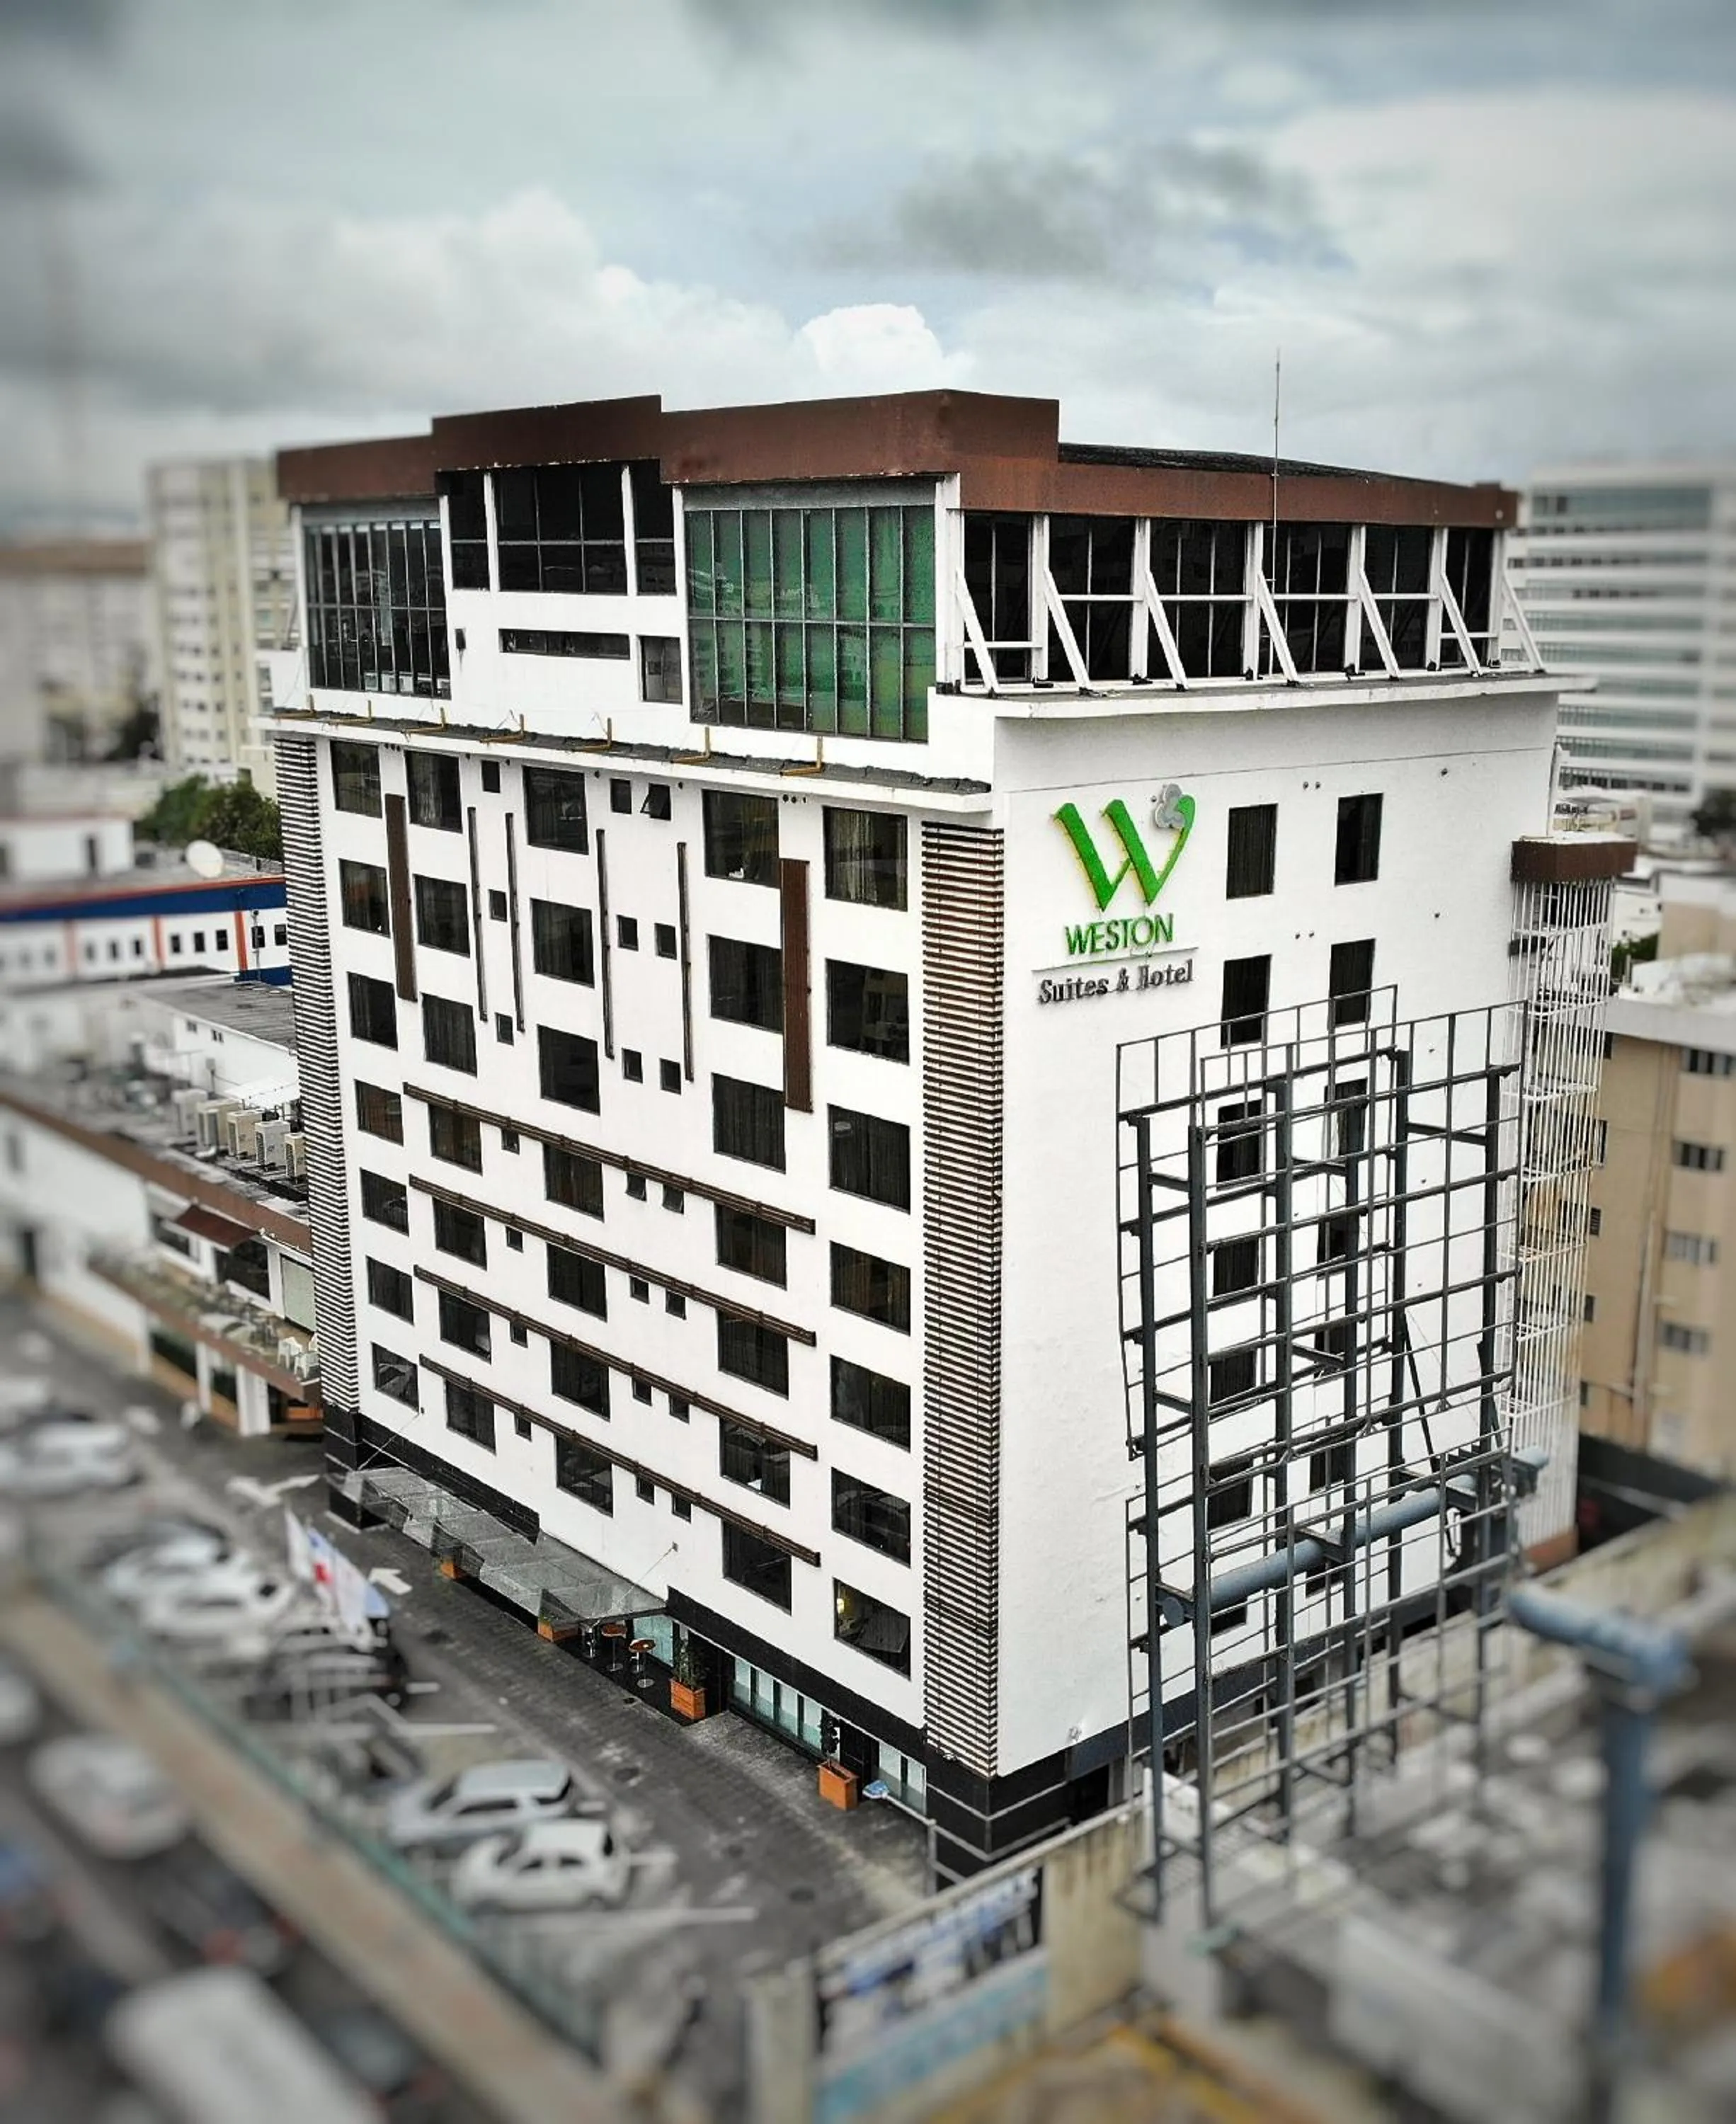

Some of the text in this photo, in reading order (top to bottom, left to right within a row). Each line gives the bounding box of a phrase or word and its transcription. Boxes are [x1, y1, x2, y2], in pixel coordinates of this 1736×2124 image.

[1052, 794, 1196, 912] W
[1064, 913, 1174, 955] WESTON
[1039, 958, 1194, 1003] Suites & Hotel
